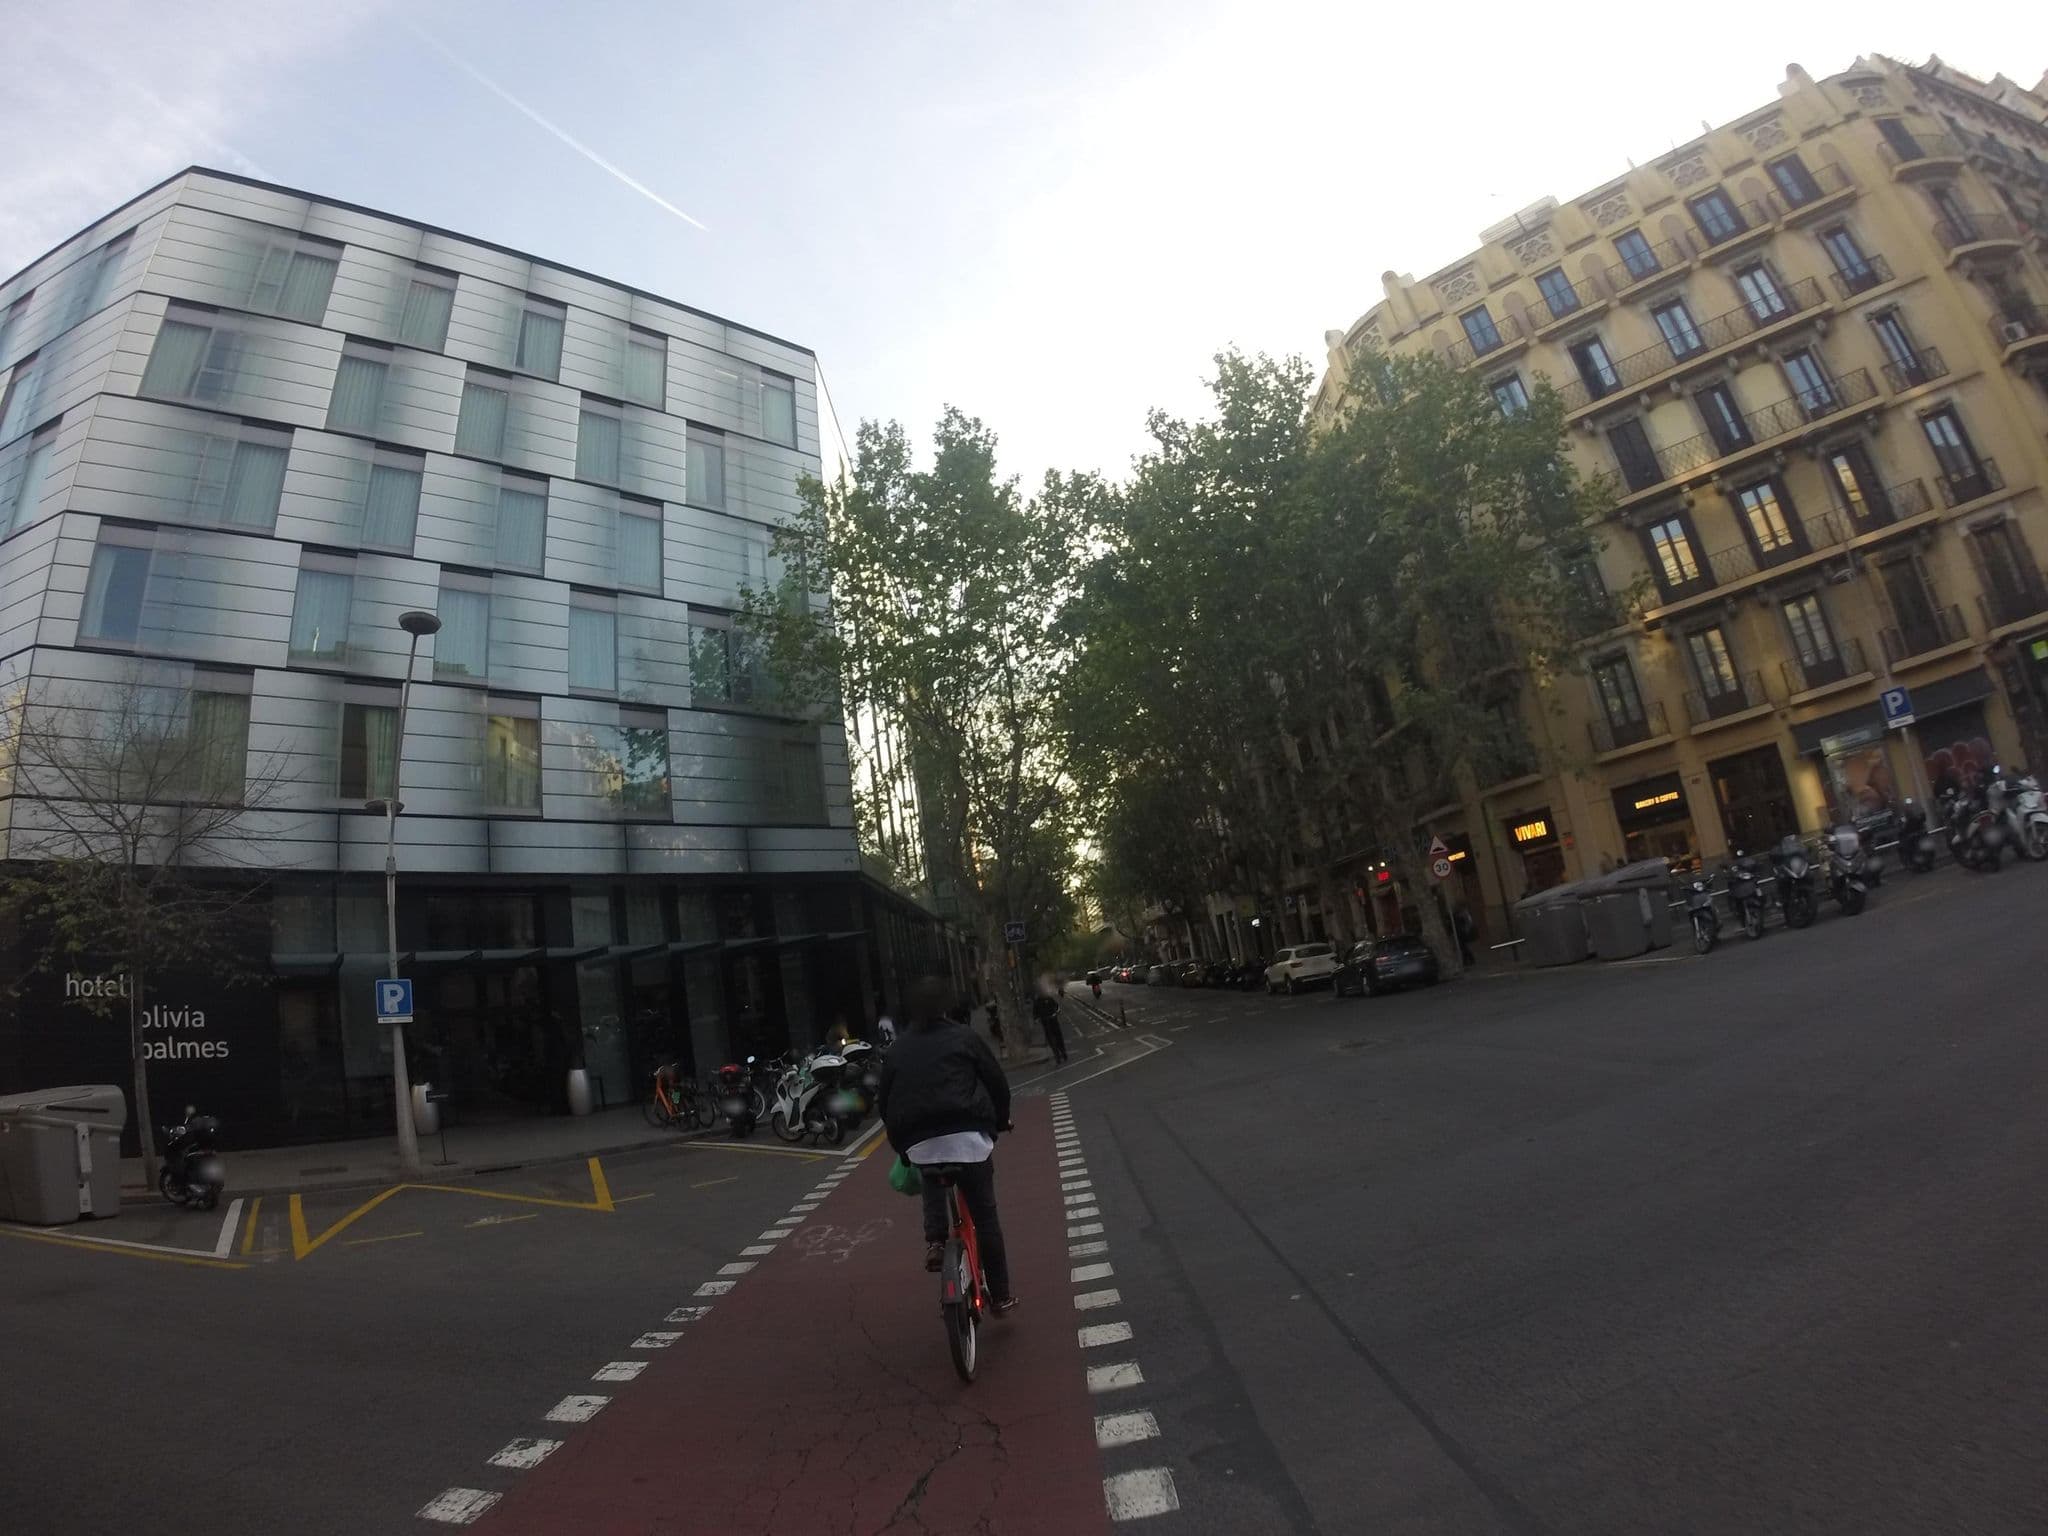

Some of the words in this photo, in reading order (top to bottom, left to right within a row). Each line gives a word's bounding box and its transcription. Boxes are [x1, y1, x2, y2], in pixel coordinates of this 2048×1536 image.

[1885, 691, 1903, 714] P
[1514, 820, 1548, 842] VIVARI
[1435, 862, 1449, 873] 30
[66, 972, 129, 997] hotel
[142, 1004, 206, 1029] olivia
